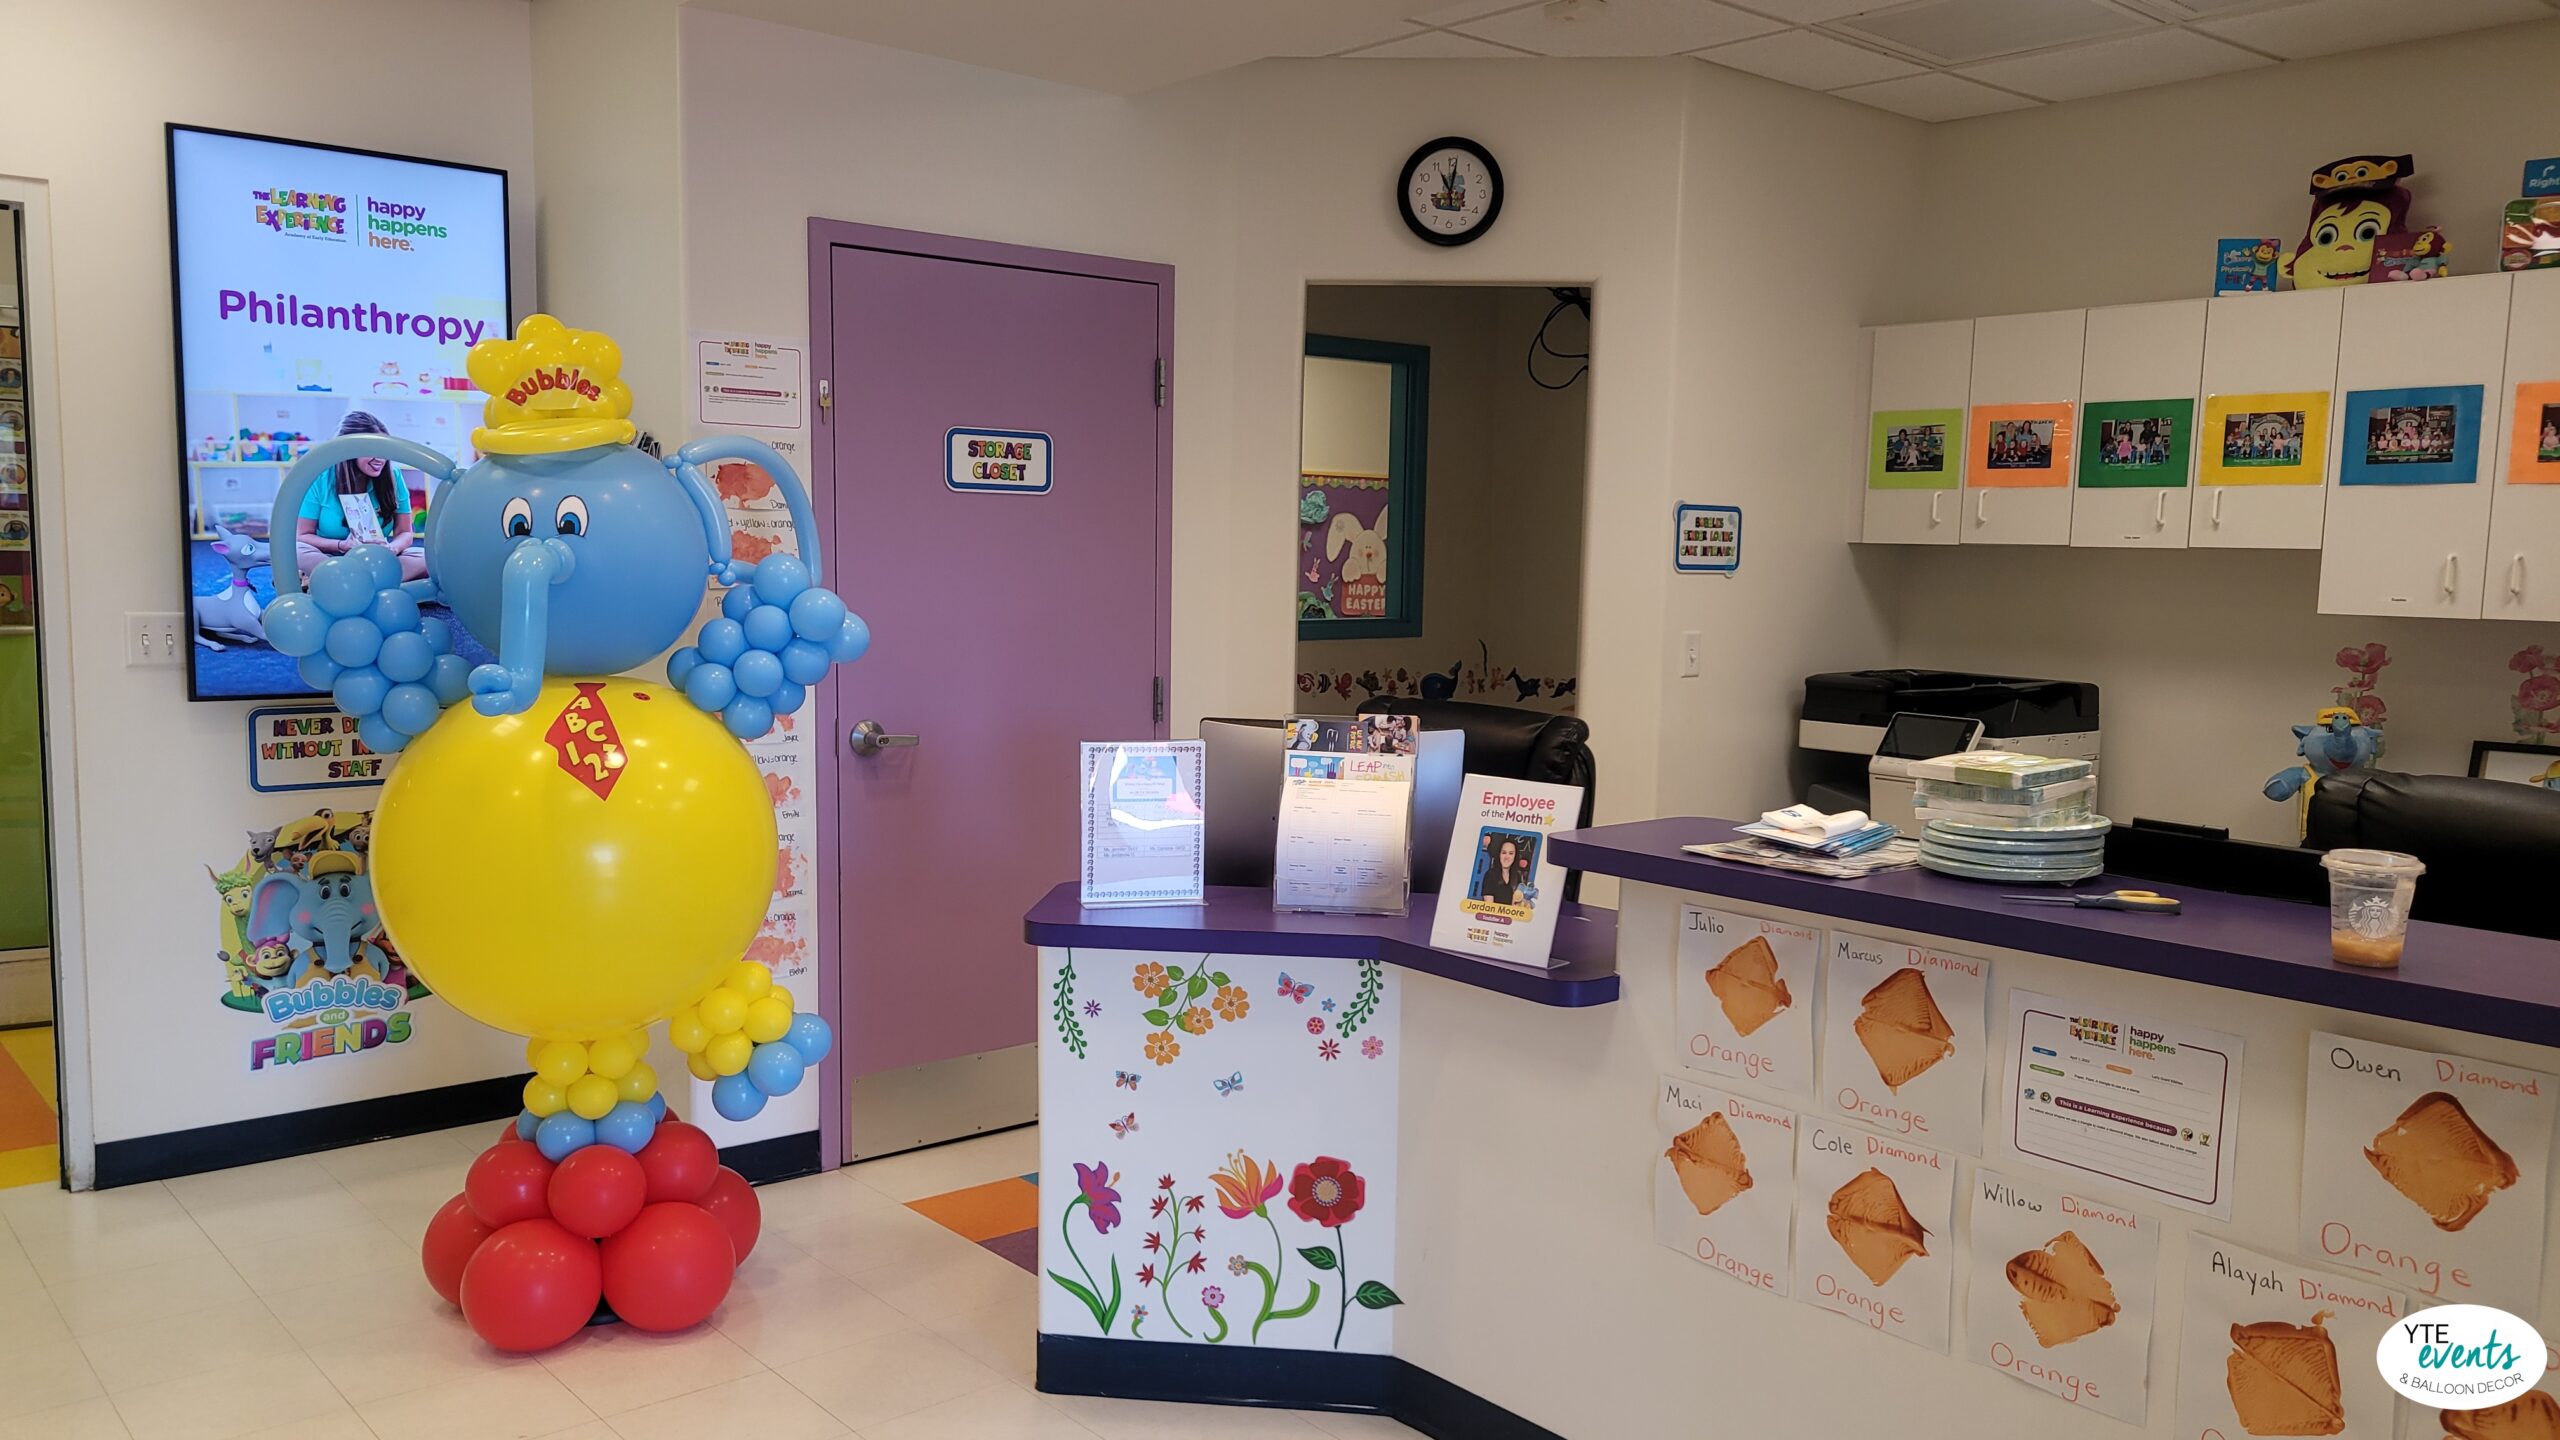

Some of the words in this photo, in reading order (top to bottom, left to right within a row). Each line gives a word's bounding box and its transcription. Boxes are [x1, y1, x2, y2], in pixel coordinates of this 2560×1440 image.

[1420, 173, 1430, 183] 10
[1476, 174, 1483, 184] 2
[252, 190, 271, 200] THE
[1416, 187, 1423, 196] 9
[1480, 190, 1486, 199] 3
[367, 196, 426, 221] happy
[1420, 204, 1427, 213] 8
[1471, 206, 1479, 214] 4
[255, 205, 344, 234] EXPERIENCE
[368, 214, 448, 239] happens
[1432, 216, 1438, 225] 7
[1446, 220, 1453, 229] 6
[1460, 217, 1467, 226] 5
[219, 289, 485, 348] Philanthropy
[506, 367, 601, 406] Bubbles
[968, 440, 1032, 460] STORAGE
[972, 461, 1026, 481] CLOSET
[1348, 584, 1386, 596] HAPPY
[273, 717, 334, 737] NEVER
[261, 739, 343, 760] WITHOUT
[328, 759, 382, 779] STAFF
[1350, 759, 1382, 773] LEAP
[1482, 791, 1555, 811] Employee
[1480, 810, 1491, 819] of
[1491, 810, 1505, 819] the
[1505, 810, 1543, 825] Month
[1466, 901, 1496, 913] Jordan
[1497, 906, 1525, 918] Moore
[1688, 911, 1724, 934] Julio
[1760, 920, 1814, 941] Diamond
[1837, 942, 1883, 965] Marcus
[1908, 948, 1979, 977] Diamond
[267, 978, 402, 1023] Bubbles
[322, 1010, 346, 1021] and
[250, 1011, 412, 1072] FRIENDS
[2130, 1025, 2164, 1043] happy
[2128, 1046, 2156, 1061] here.
[2129, 1036, 2176, 1055] happens
[1690, 1033, 1775, 1079] Orange
[2330, 1047, 2401, 1082] Owen
[2436, 1059, 2540, 1097] Diamond
[1667, 1085, 1702, 1111] Maci
[1728, 1099, 1792, 1130] Diamond
[1838, 1087, 1928, 1134] Orange
[2060, 1099, 2072, 1108] This
[2084, 1106, 2110, 1118] Learning
[2111, 1113, 2144, 1127] Experience
[1812, 1128, 1853, 1155] Cole
[1866, 1136, 1942, 1170] Diamond
[1983, 1181, 2043, 1213] Willow
[2061, 1196, 2137, 1230] Diamond
[1697, 1237, 1774, 1289] Orange
[2321, 1221, 2472, 1296] Orange
[2212, 1251, 2284, 1296] Alayah
[2300, 1278, 2397, 1318] Diamond
[1815, 1273, 1905, 1330] Orange
[1990, 1342, 2100, 1402] Orange
